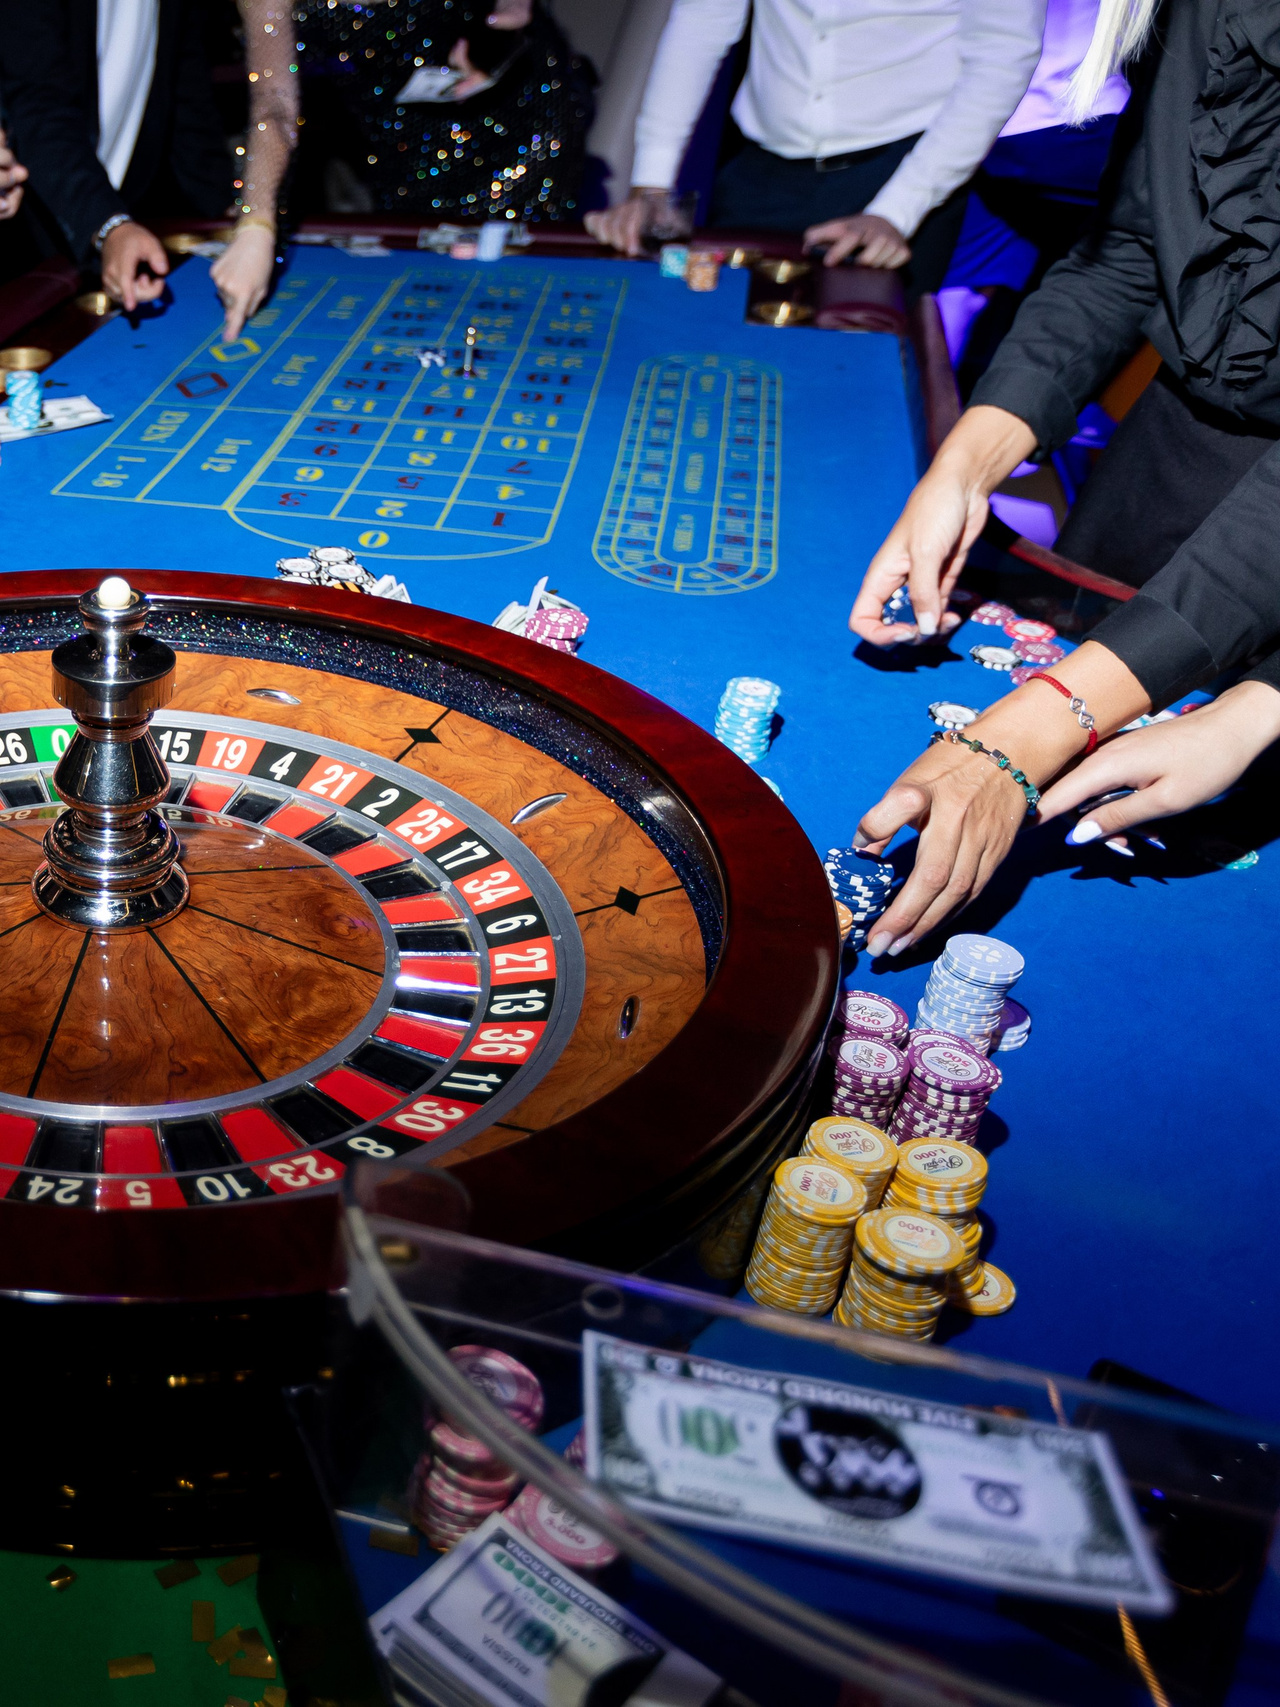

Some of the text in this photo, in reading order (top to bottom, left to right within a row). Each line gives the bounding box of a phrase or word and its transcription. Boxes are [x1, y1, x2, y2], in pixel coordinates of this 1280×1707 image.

[430, 385, 475, 399] 17
[332, 398, 376, 412] 15
[423, 405, 464, 418] 14
[315, 421, 362, 434] 12
[512, 412, 558, 428] 13
[413, 428, 456, 444] 11
[501, 436, 550, 452] 10
[314, 444, 339, 456] 9
[407, 451, 437, 466] 8
[294, 466, 324, 482] 6
[507, 461, 532, 474] 7
[92, 472, 129, 488] 18
[397, 476, 424, 490] 5
[278, 492, 308, 506] 3
[496, 484, 525, 500] 4
[375, 500, 408, 518] 2
[492, 512, 507, 526] 1
[358, 530, 390, 548] 0
[52, 728, 72, 756] 0
[158, 731, 192, 762] 15
[211, 738, 248, 770] 19
[269, 751, 298, 781] 4
[309, 764, 359, 801] 21
[361, 788, 400, 818] 2
[399, 808, 454, 844] 25
[436, 840, 491, 871] 17
[463, 870, 520, 906] 34
[486, 914, 538, 934] 6
[493, 947, 550, 976] 27
[490, 988, 547, 1016] 13
[852, 1014, 881, 1026] 500
[470, 1028, 535, 1057] 36
[874, 1052, 888, 1070] 500
[942, 1052, 972, 1068] 500
[440, 1071, 502, 1096] 11
[394, 1100, 466, 1132] 30
[829, 1130, 861, 1140] 1.000
[346, 1136, 394, 1158] 8
[914, 1148, 947, 1160] 1.000
[268, 1155, 335, 1188] 23
[799, 1170, 814, 1192] 1.000
[27, 1175, 84, 1204] 24
[124, 1180, 152, 1206] 5
[196, 1174, 252, 1202] 10
[898, 1220, 936, 1236] 1.000
[782, 1380, 913, 1420] HUNDRED
[505, 1538, 551, 1579] KRONA
[549, 1576, 624, 1631] THOUSAND
